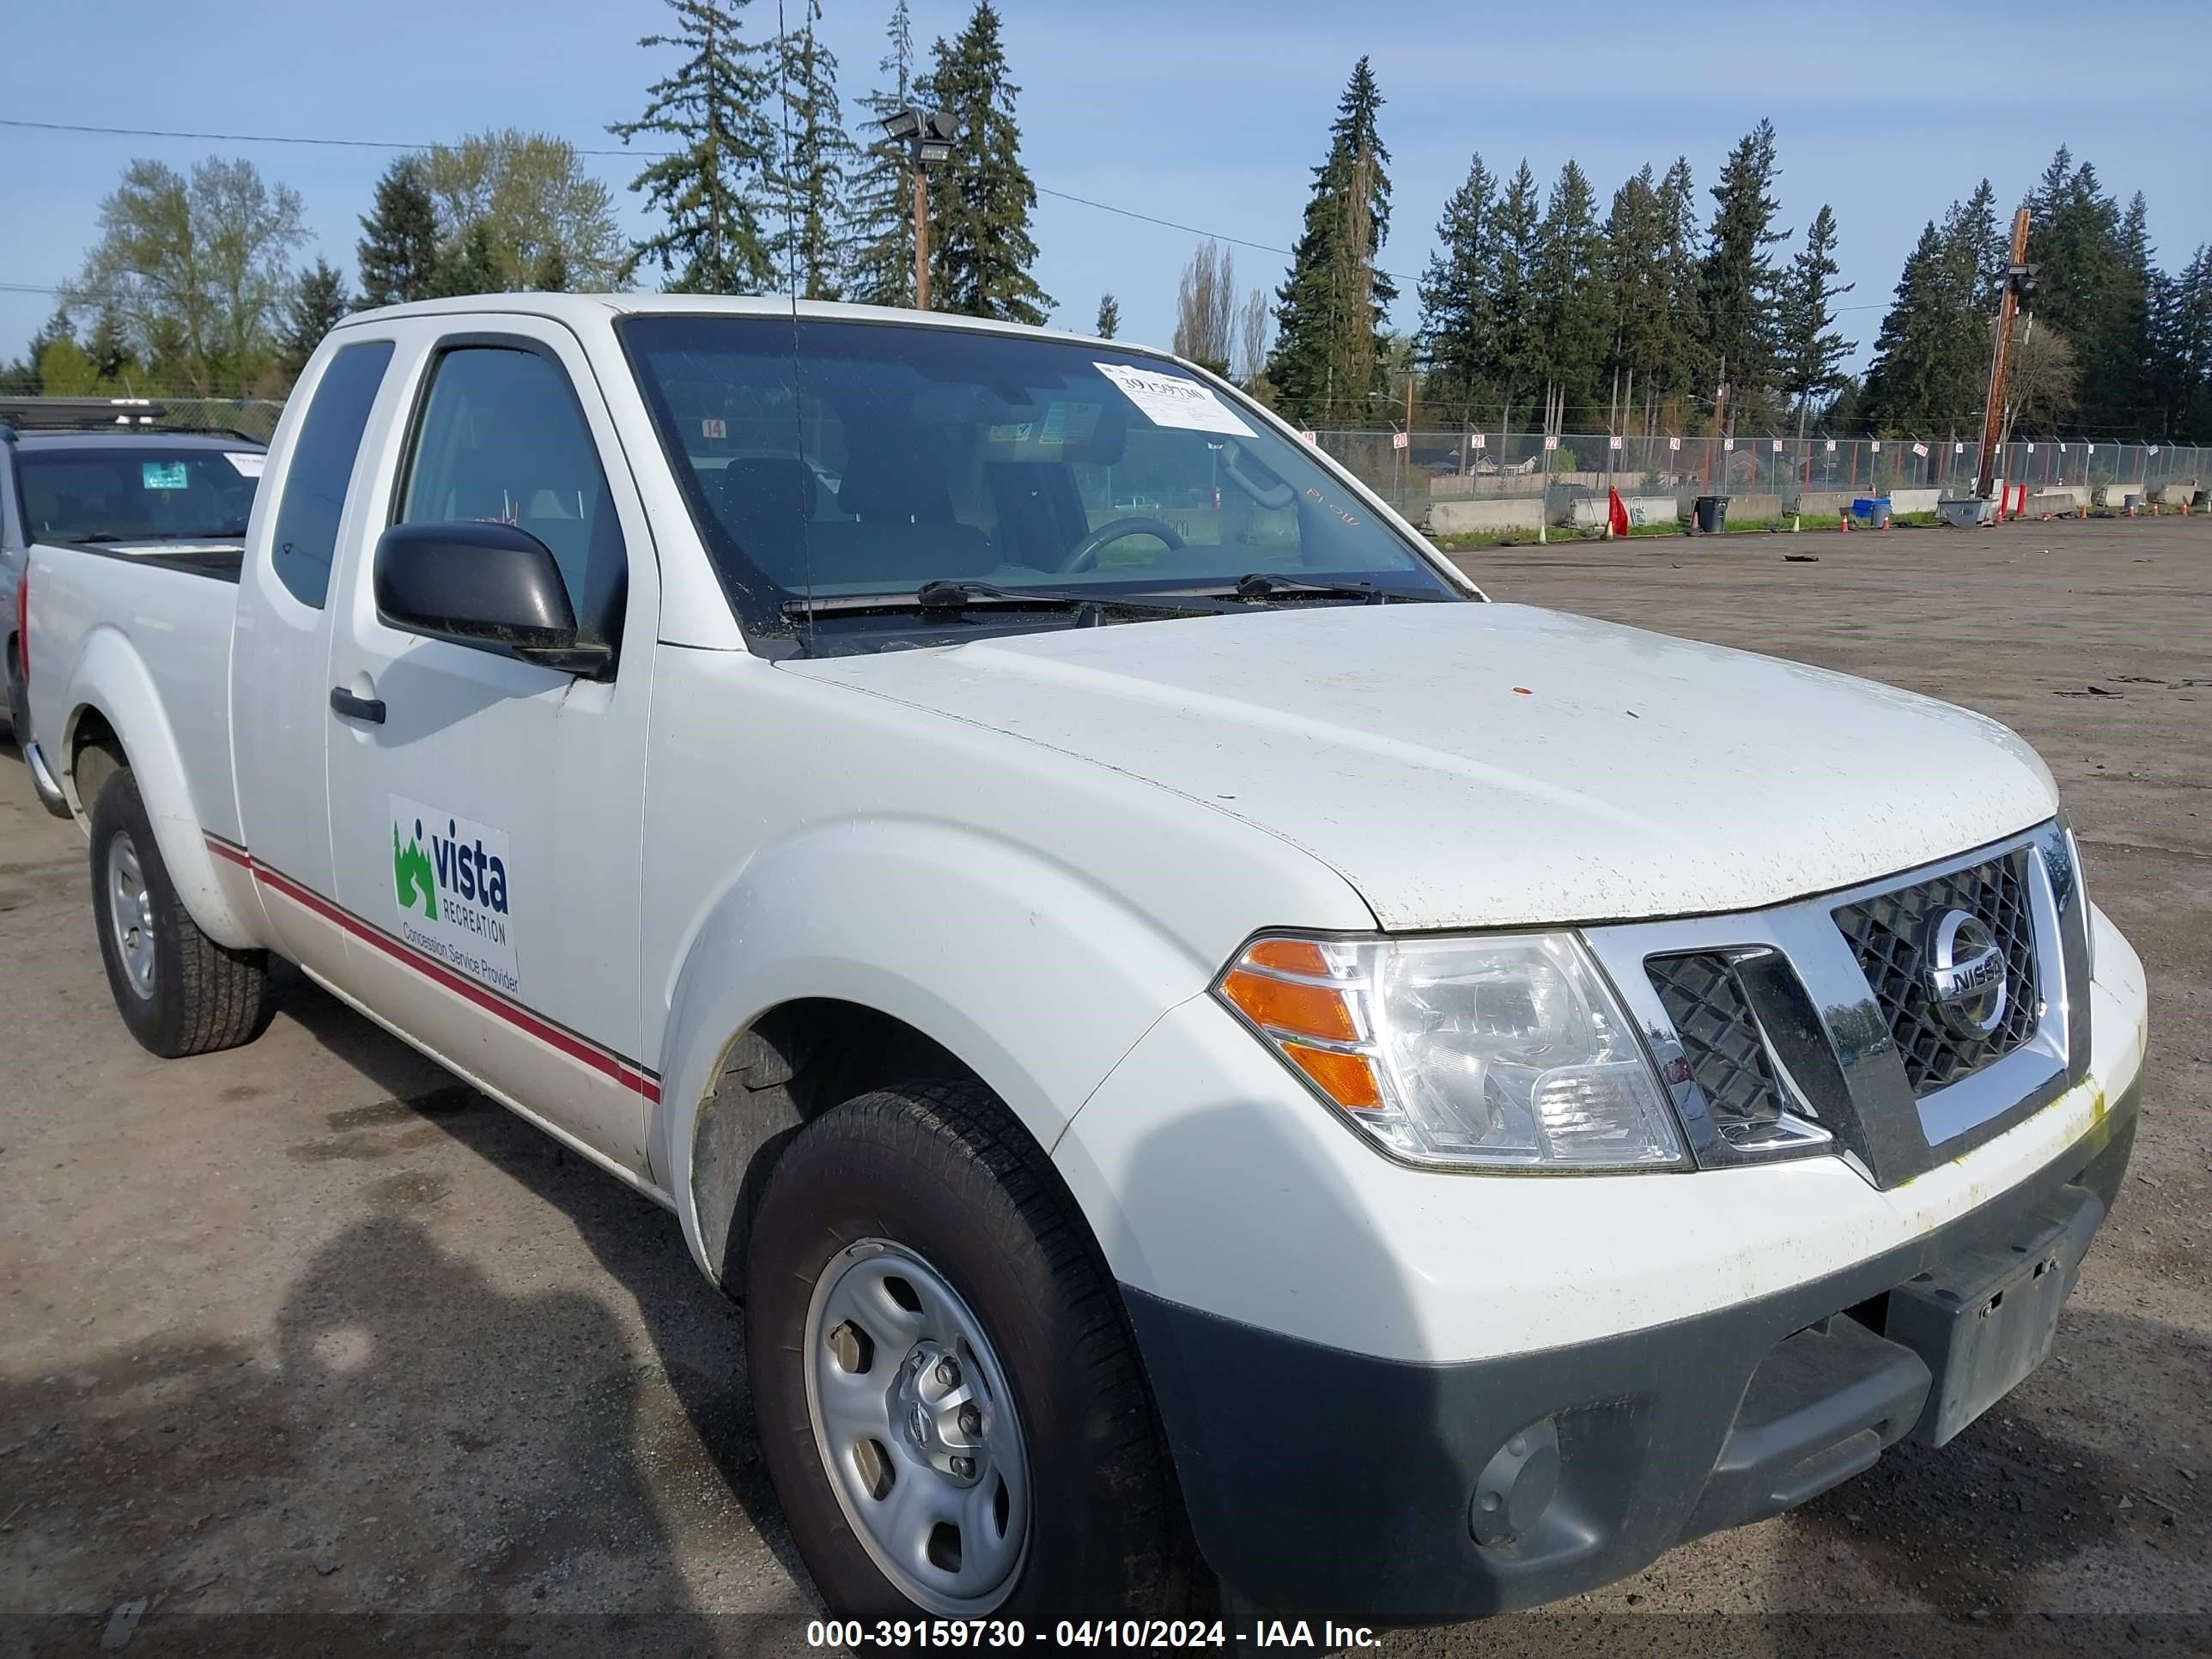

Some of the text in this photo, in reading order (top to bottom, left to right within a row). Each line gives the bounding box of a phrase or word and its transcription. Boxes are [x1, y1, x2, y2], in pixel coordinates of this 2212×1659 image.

[706, 421, 722, 436] 14
[1395, 434, 1406, 447] 20
[1474, 435, 1483, 447] 21
[1547, 438, 1556, 448] 22
[1611, 438, 1620, 448] 23
[1670, 438, 1679, 449] 24
[1725, 440, 1733, 449] 25
[1916, 445, 1927, 455] 29
[432, 818, 508, 915] vista
[443, 898, 506, 946] RECREATION
[403, 921, 518, 994] Concession Service Provider
[1953, 954, 2006, 994] NISSA
